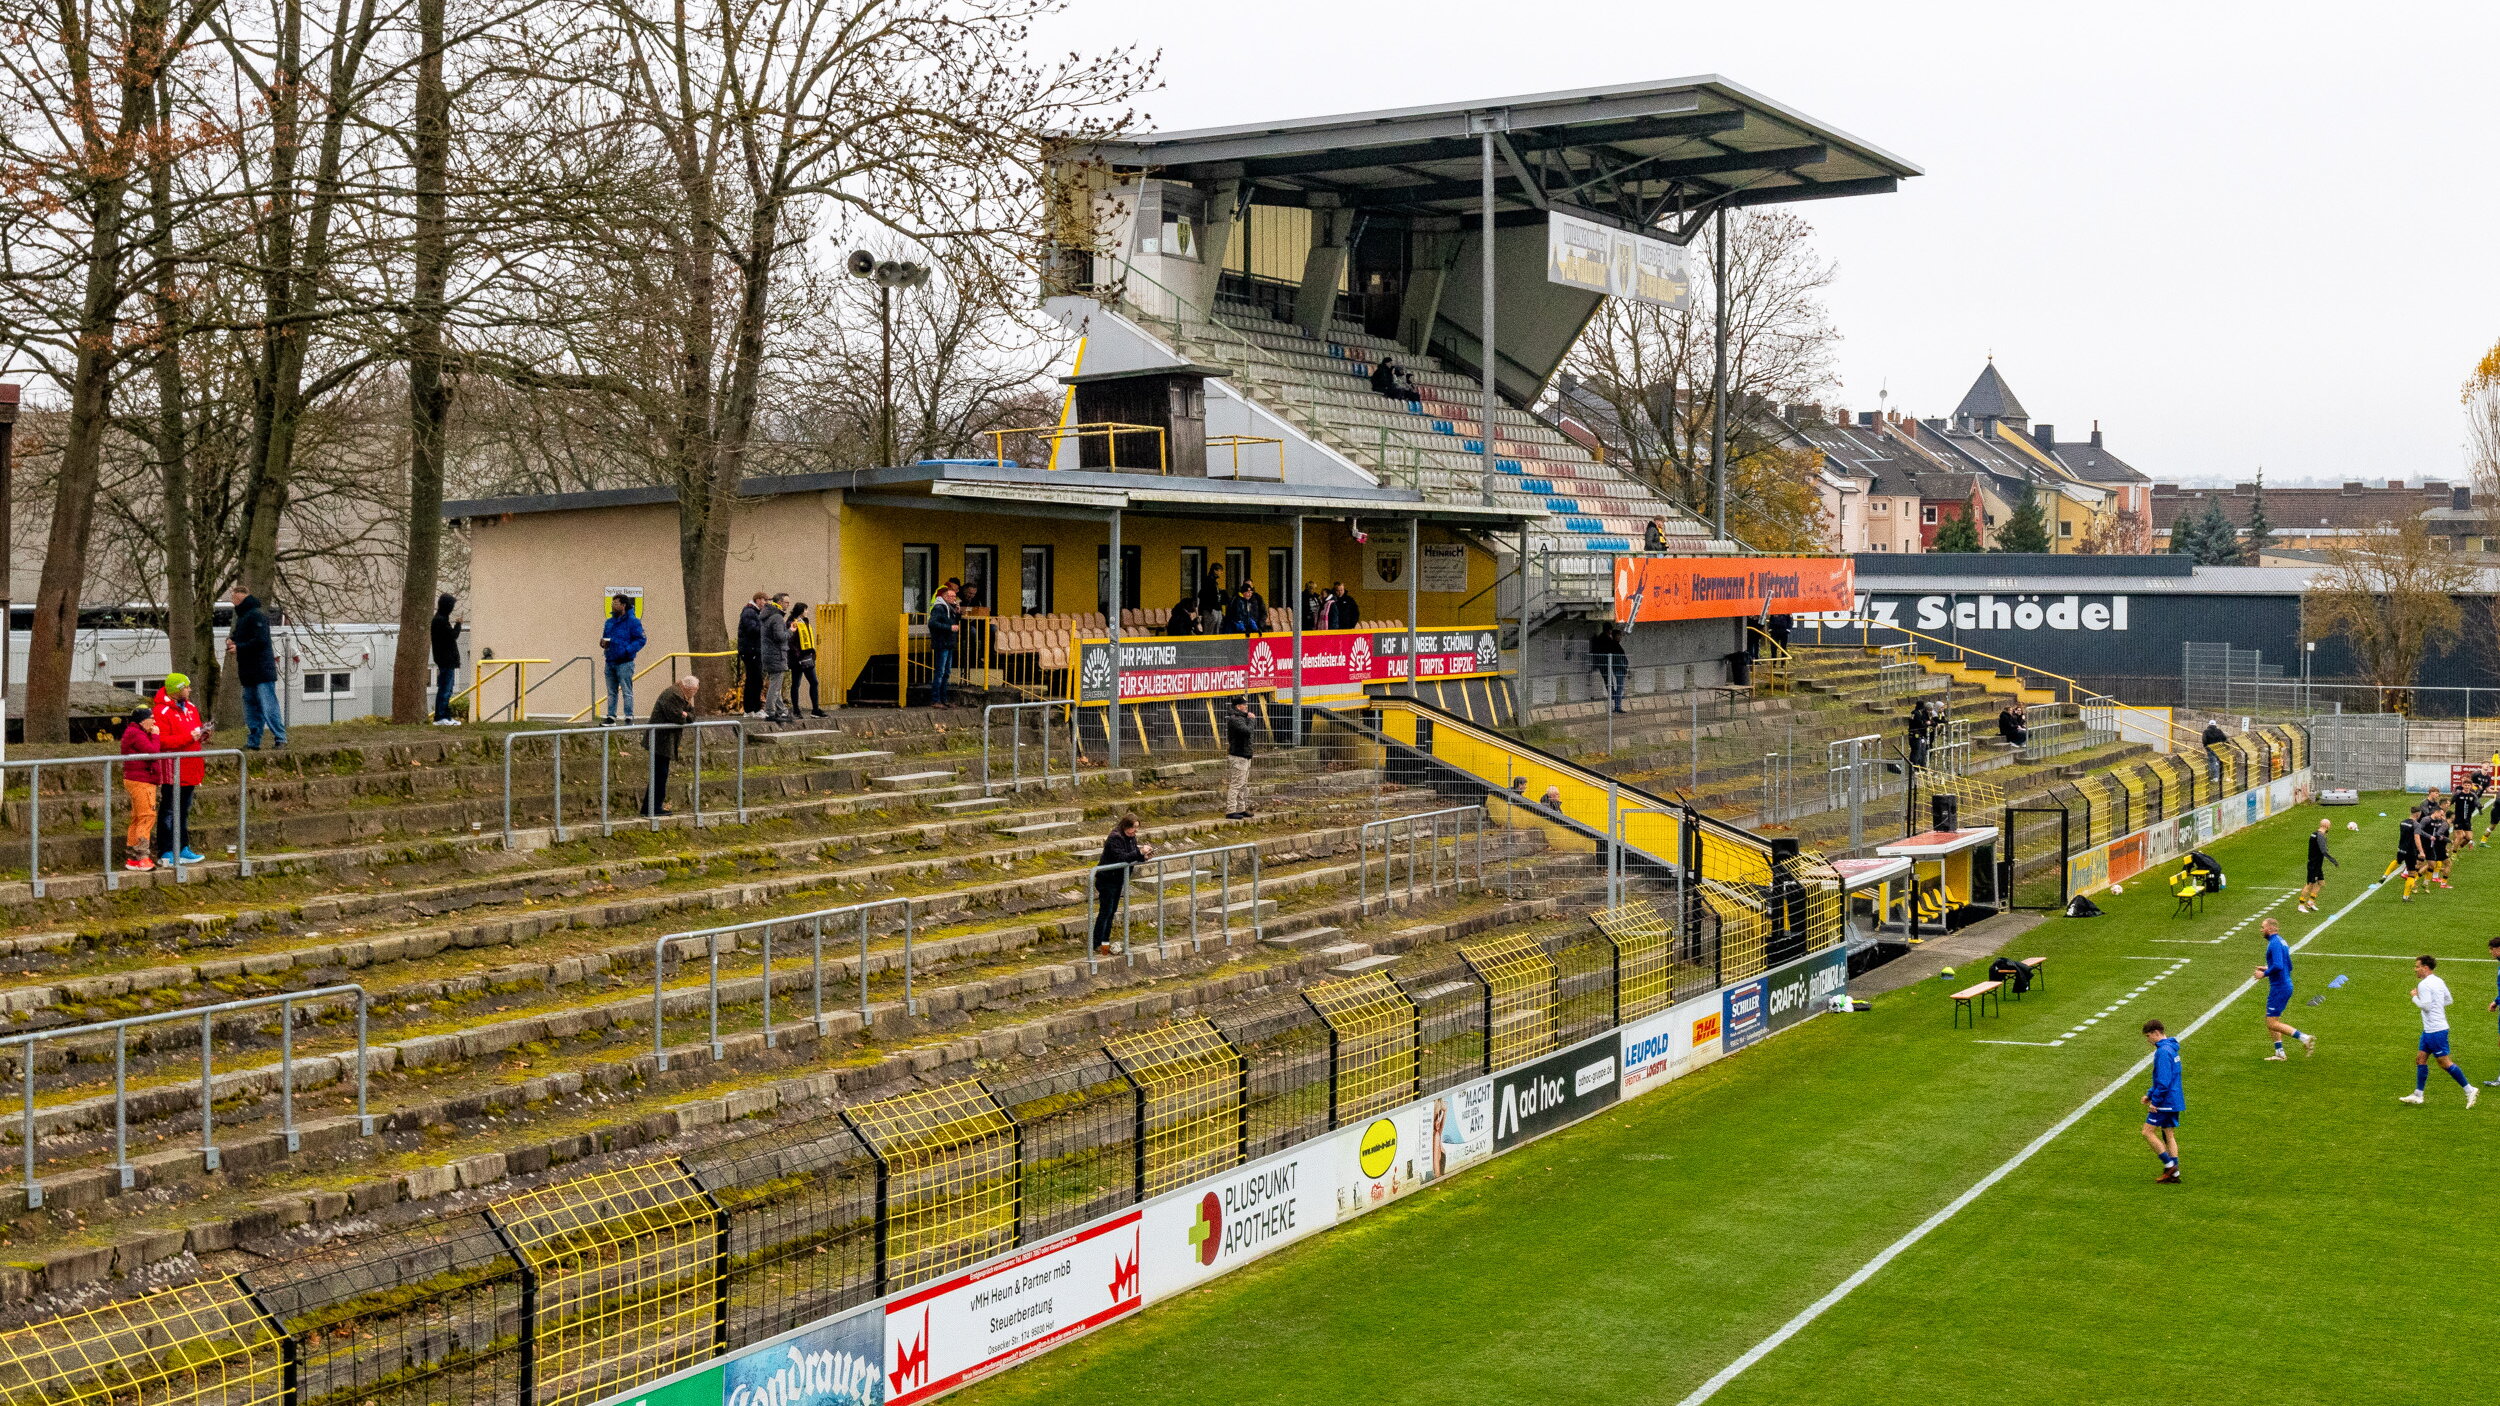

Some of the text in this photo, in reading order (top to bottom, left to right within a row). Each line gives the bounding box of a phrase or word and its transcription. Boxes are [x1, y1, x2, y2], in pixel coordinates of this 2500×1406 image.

[1424, 545, 1464, 557] HEINRICH
[1692, 573, 1745, 601] Herrmann
[1748, 572, 1755, 599] &
[1917, 595, 2128, 630] Schödel
[1382, 632, 1473, 654] HOF NNBERG SCHÖNAU
[1119, 646, 1177, 666] IHR PARTNER
[1357, 655, 1364, 671] SF
[1388, 658, 1409, 676] PLAUE
[1420, 657, 1444, 674] TRIPTIS
[1450, 656, 1473, 673] LEIPZIG
[1484, 649, 1491, 664] SF
[1092, 669, 1103, 688] SF
[1258, 661, 1266, 677] SF
[1119, 669, 1245, 696] FÜR SAUBERKEIT UND HYGIENE
[1732, 995, 1759, 1017] SCHILLER
[1770, 982, 1799, 1015] CRAFT
[1694, 1018, 1718, 1042] DHL
[1625, 1033, 1668, 1068] LEUPOLD
[1578, 1064, 1613, 1087] adhoc-gruppe.de
[1646, 1058, 1667, 1079] LOGISTIK
[1466, 1084, 1491, 1108] MACHT
[1520, 1075, 1565, 1118] ad hoc
[1470, 1114, 1484, 1134] AN?
[1226, 1162, 1298, 1216] PLUSPUNKT
[1225, 1198, 1296, 1256] APOTHEKE
[970, 1260, 1071, 1312] vMH Heun & Partner mbB
[990, 1297, 1053, 1333] Steuerberatung
[988, 1339, 1011, 1355] Ossecker
[1011, 1335, 1020, 1346] Str.
[1021, 1331, 1030, 1342] 174
